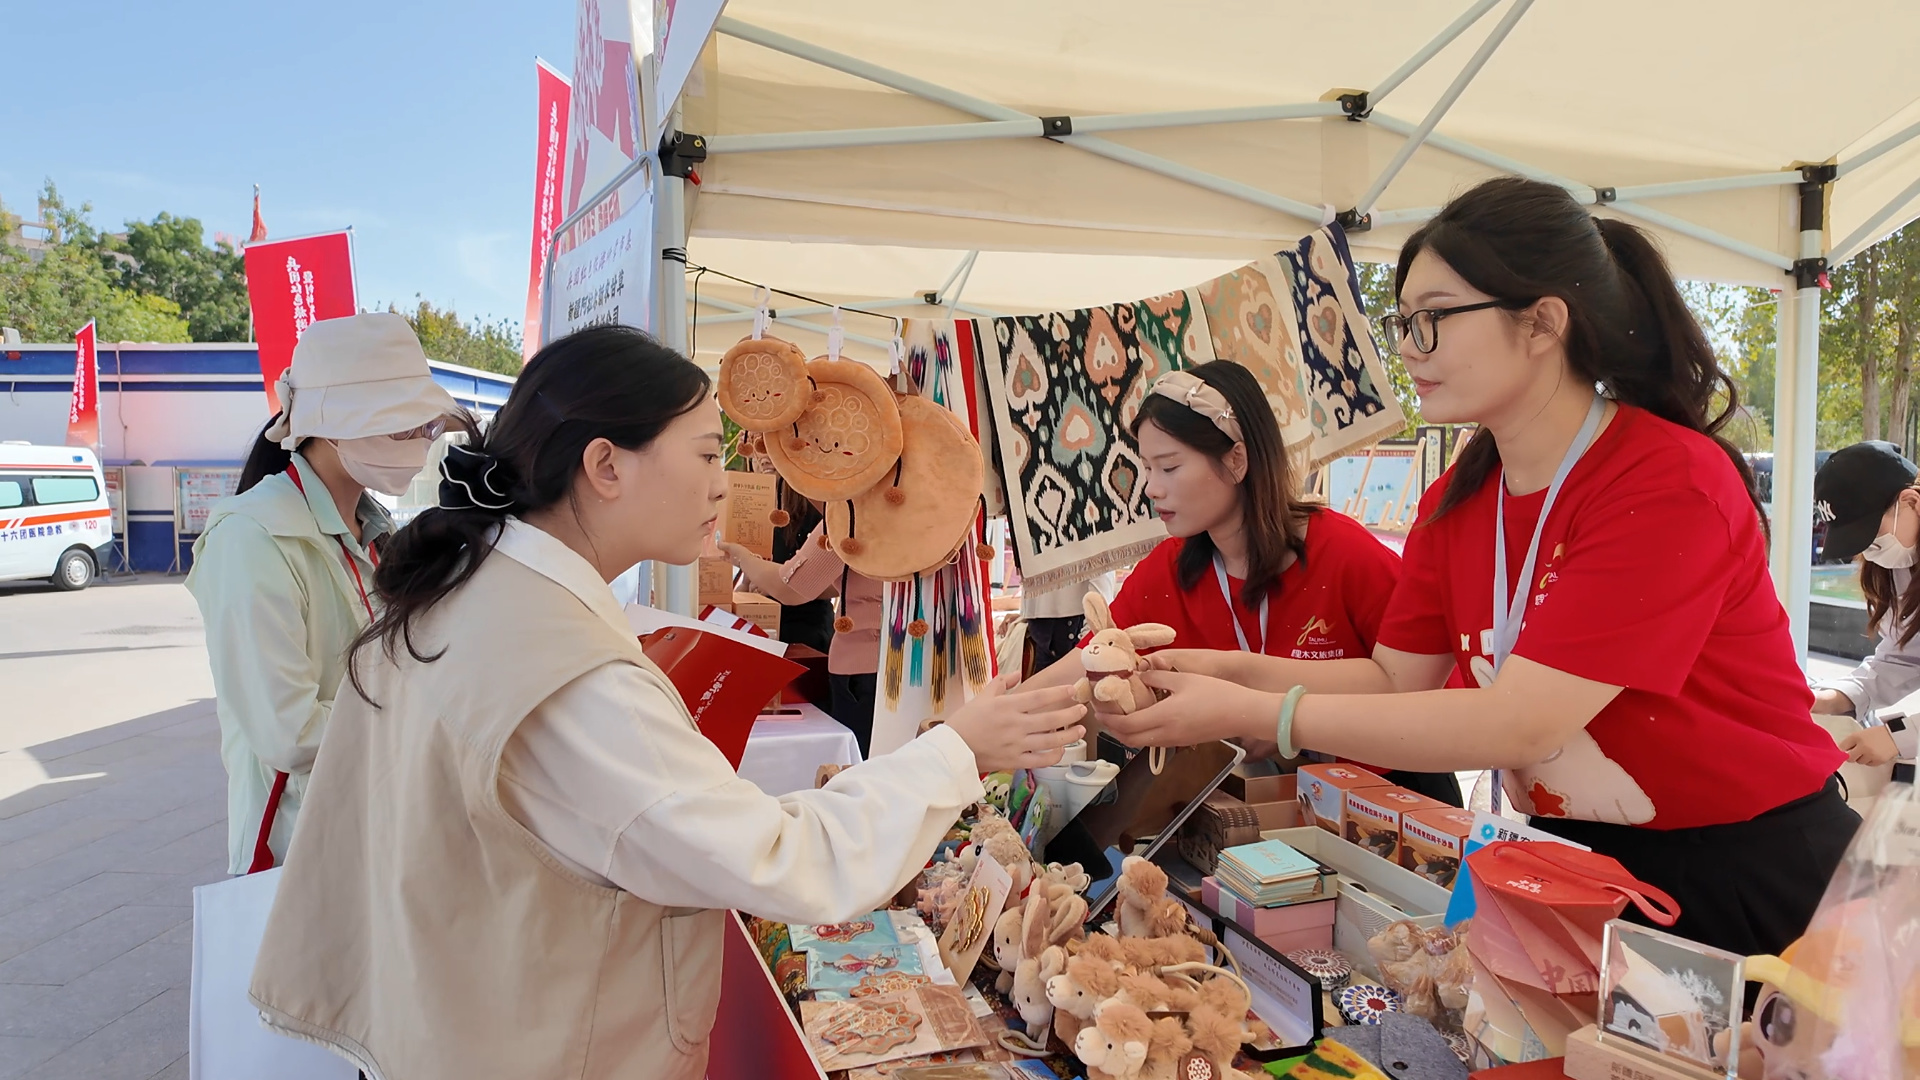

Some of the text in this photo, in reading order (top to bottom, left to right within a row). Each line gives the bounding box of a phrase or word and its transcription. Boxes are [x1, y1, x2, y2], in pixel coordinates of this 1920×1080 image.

[1817, 500, 1837, 522] NY
[1, 524, 63, 541] 十六团医院急救
[84, 520, 97, 530] 120
[1497, 827, 1536, 843] 新疆
[1540, 958, 1595, 998] 中国
